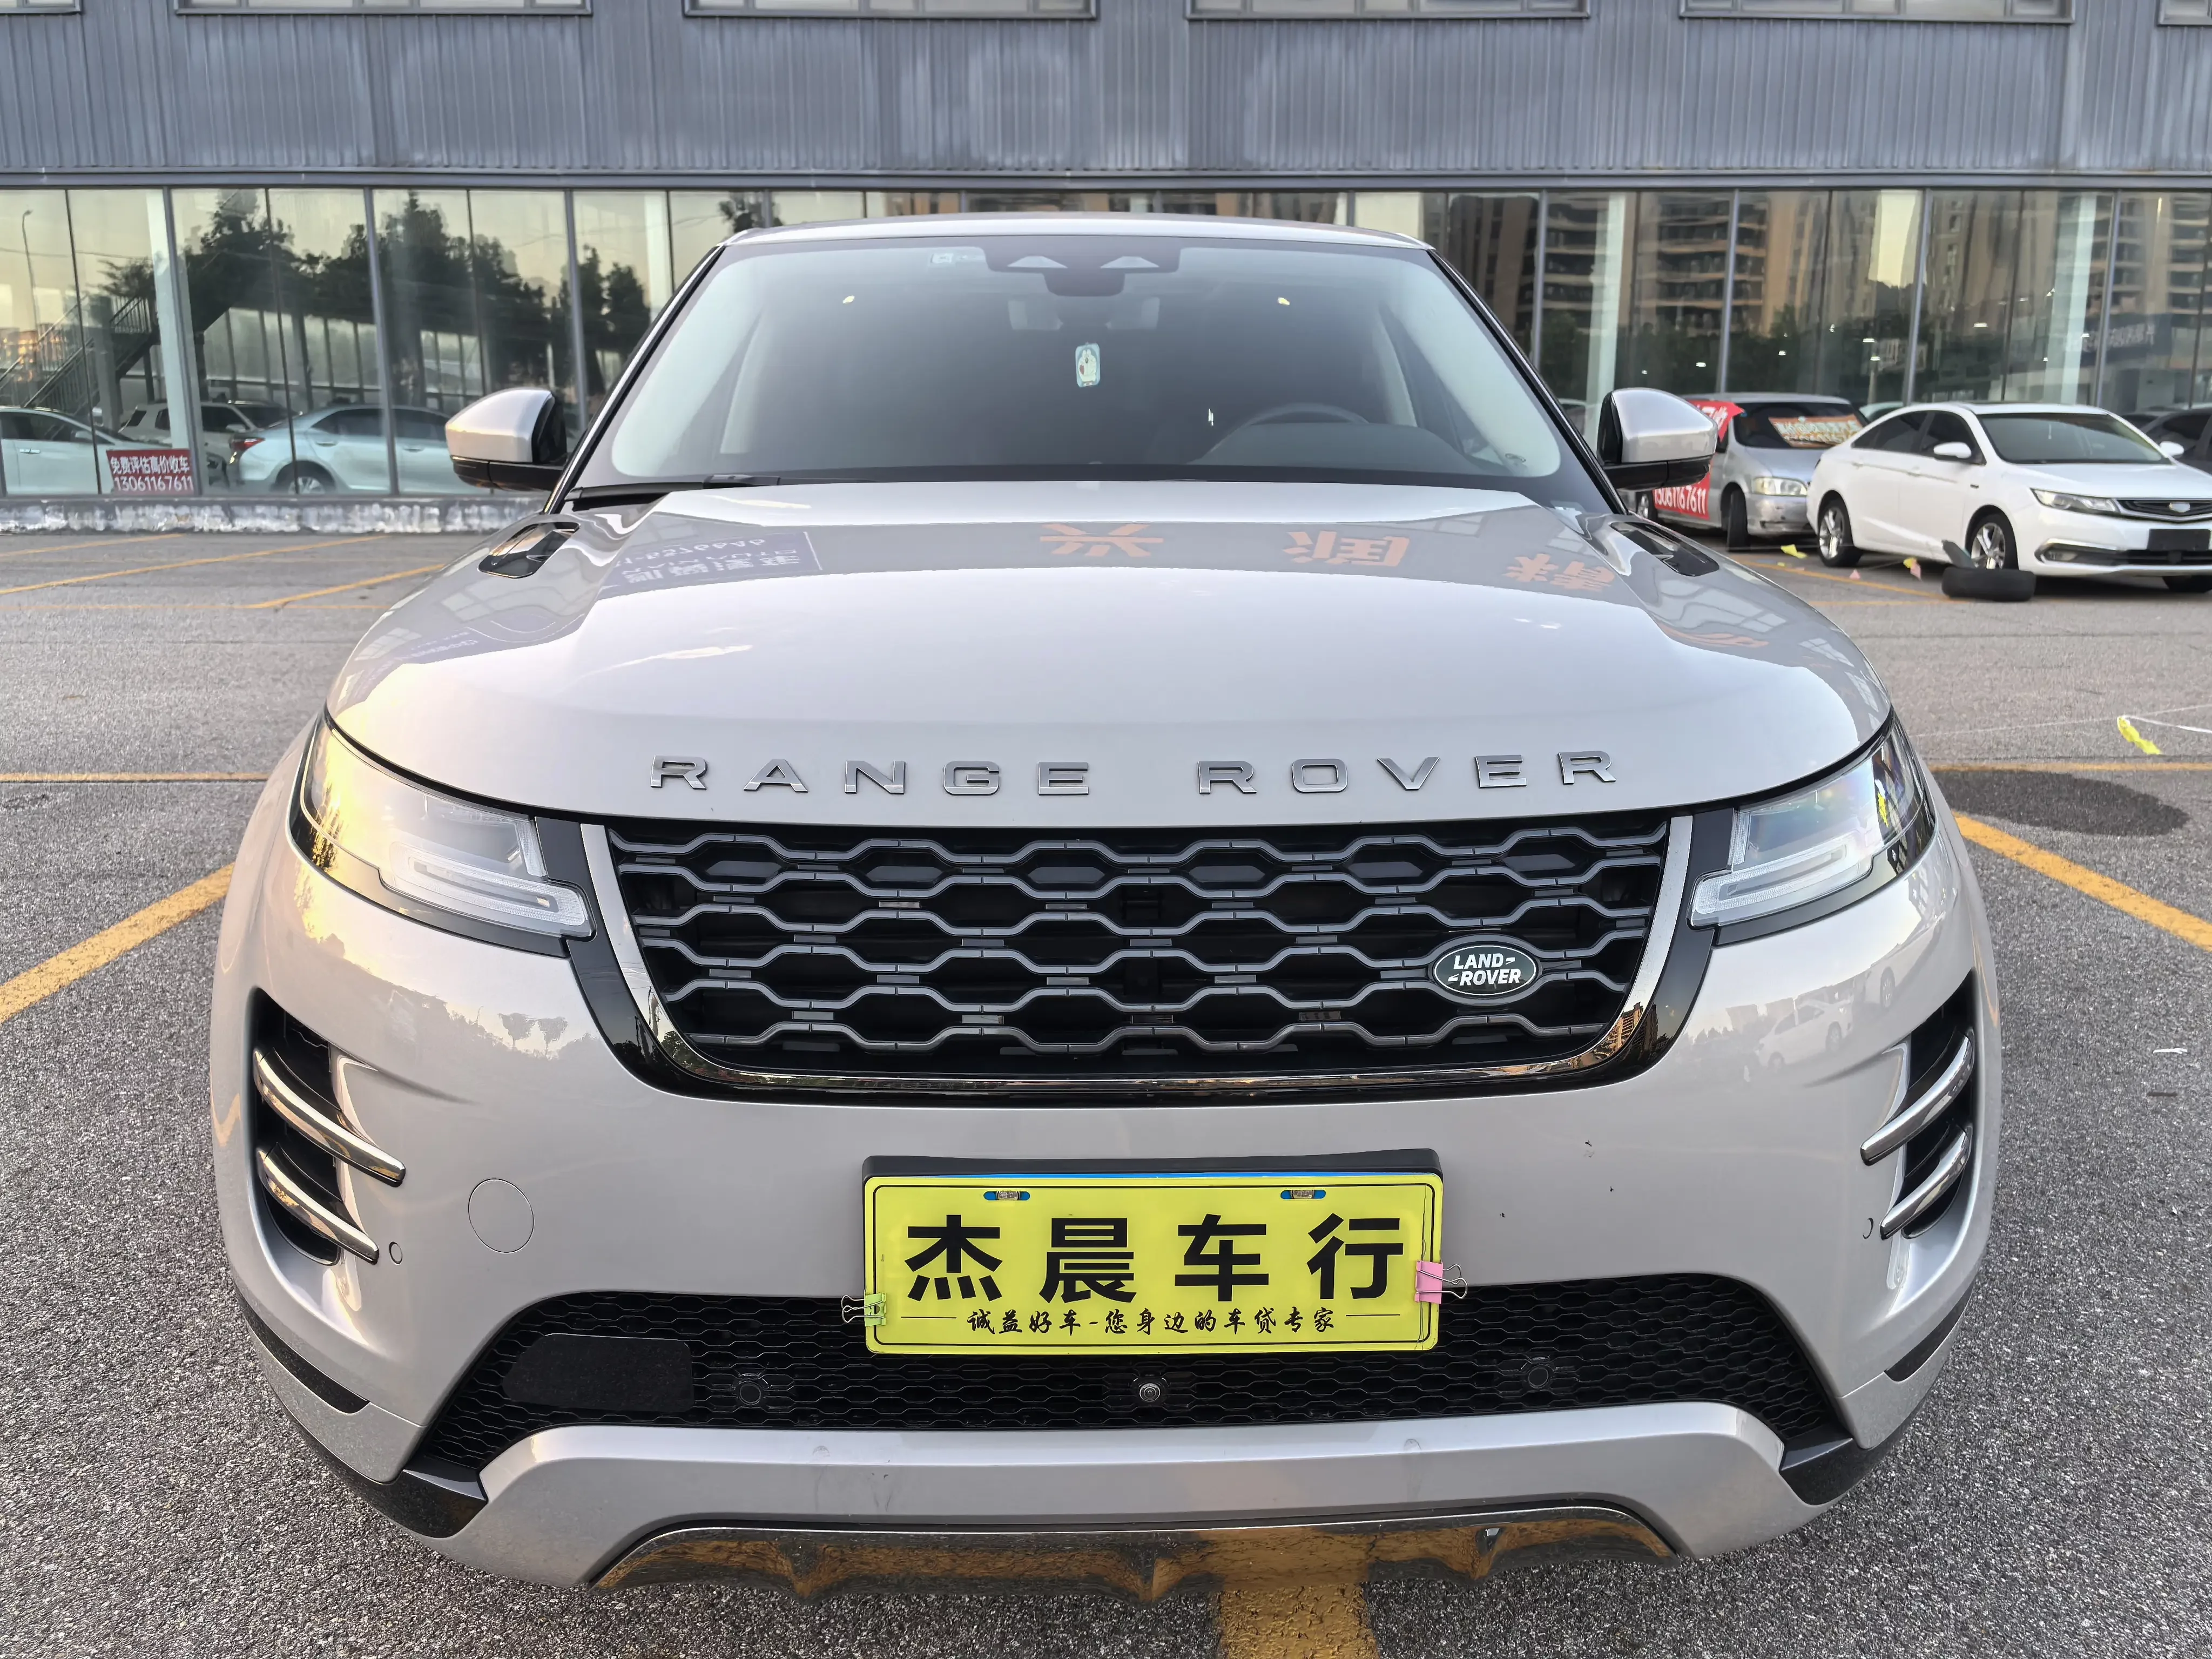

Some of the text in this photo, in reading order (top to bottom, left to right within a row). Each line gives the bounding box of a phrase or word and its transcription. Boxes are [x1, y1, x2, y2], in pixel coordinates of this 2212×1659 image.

[110, 455, 190, 474] 免费评估高价收车
[114, 475, 193, 491] 13061167611
[650, 750, 1617, 796] RANGE ROVER
[904, 1213, 1404, 1303] 杰晨车行
